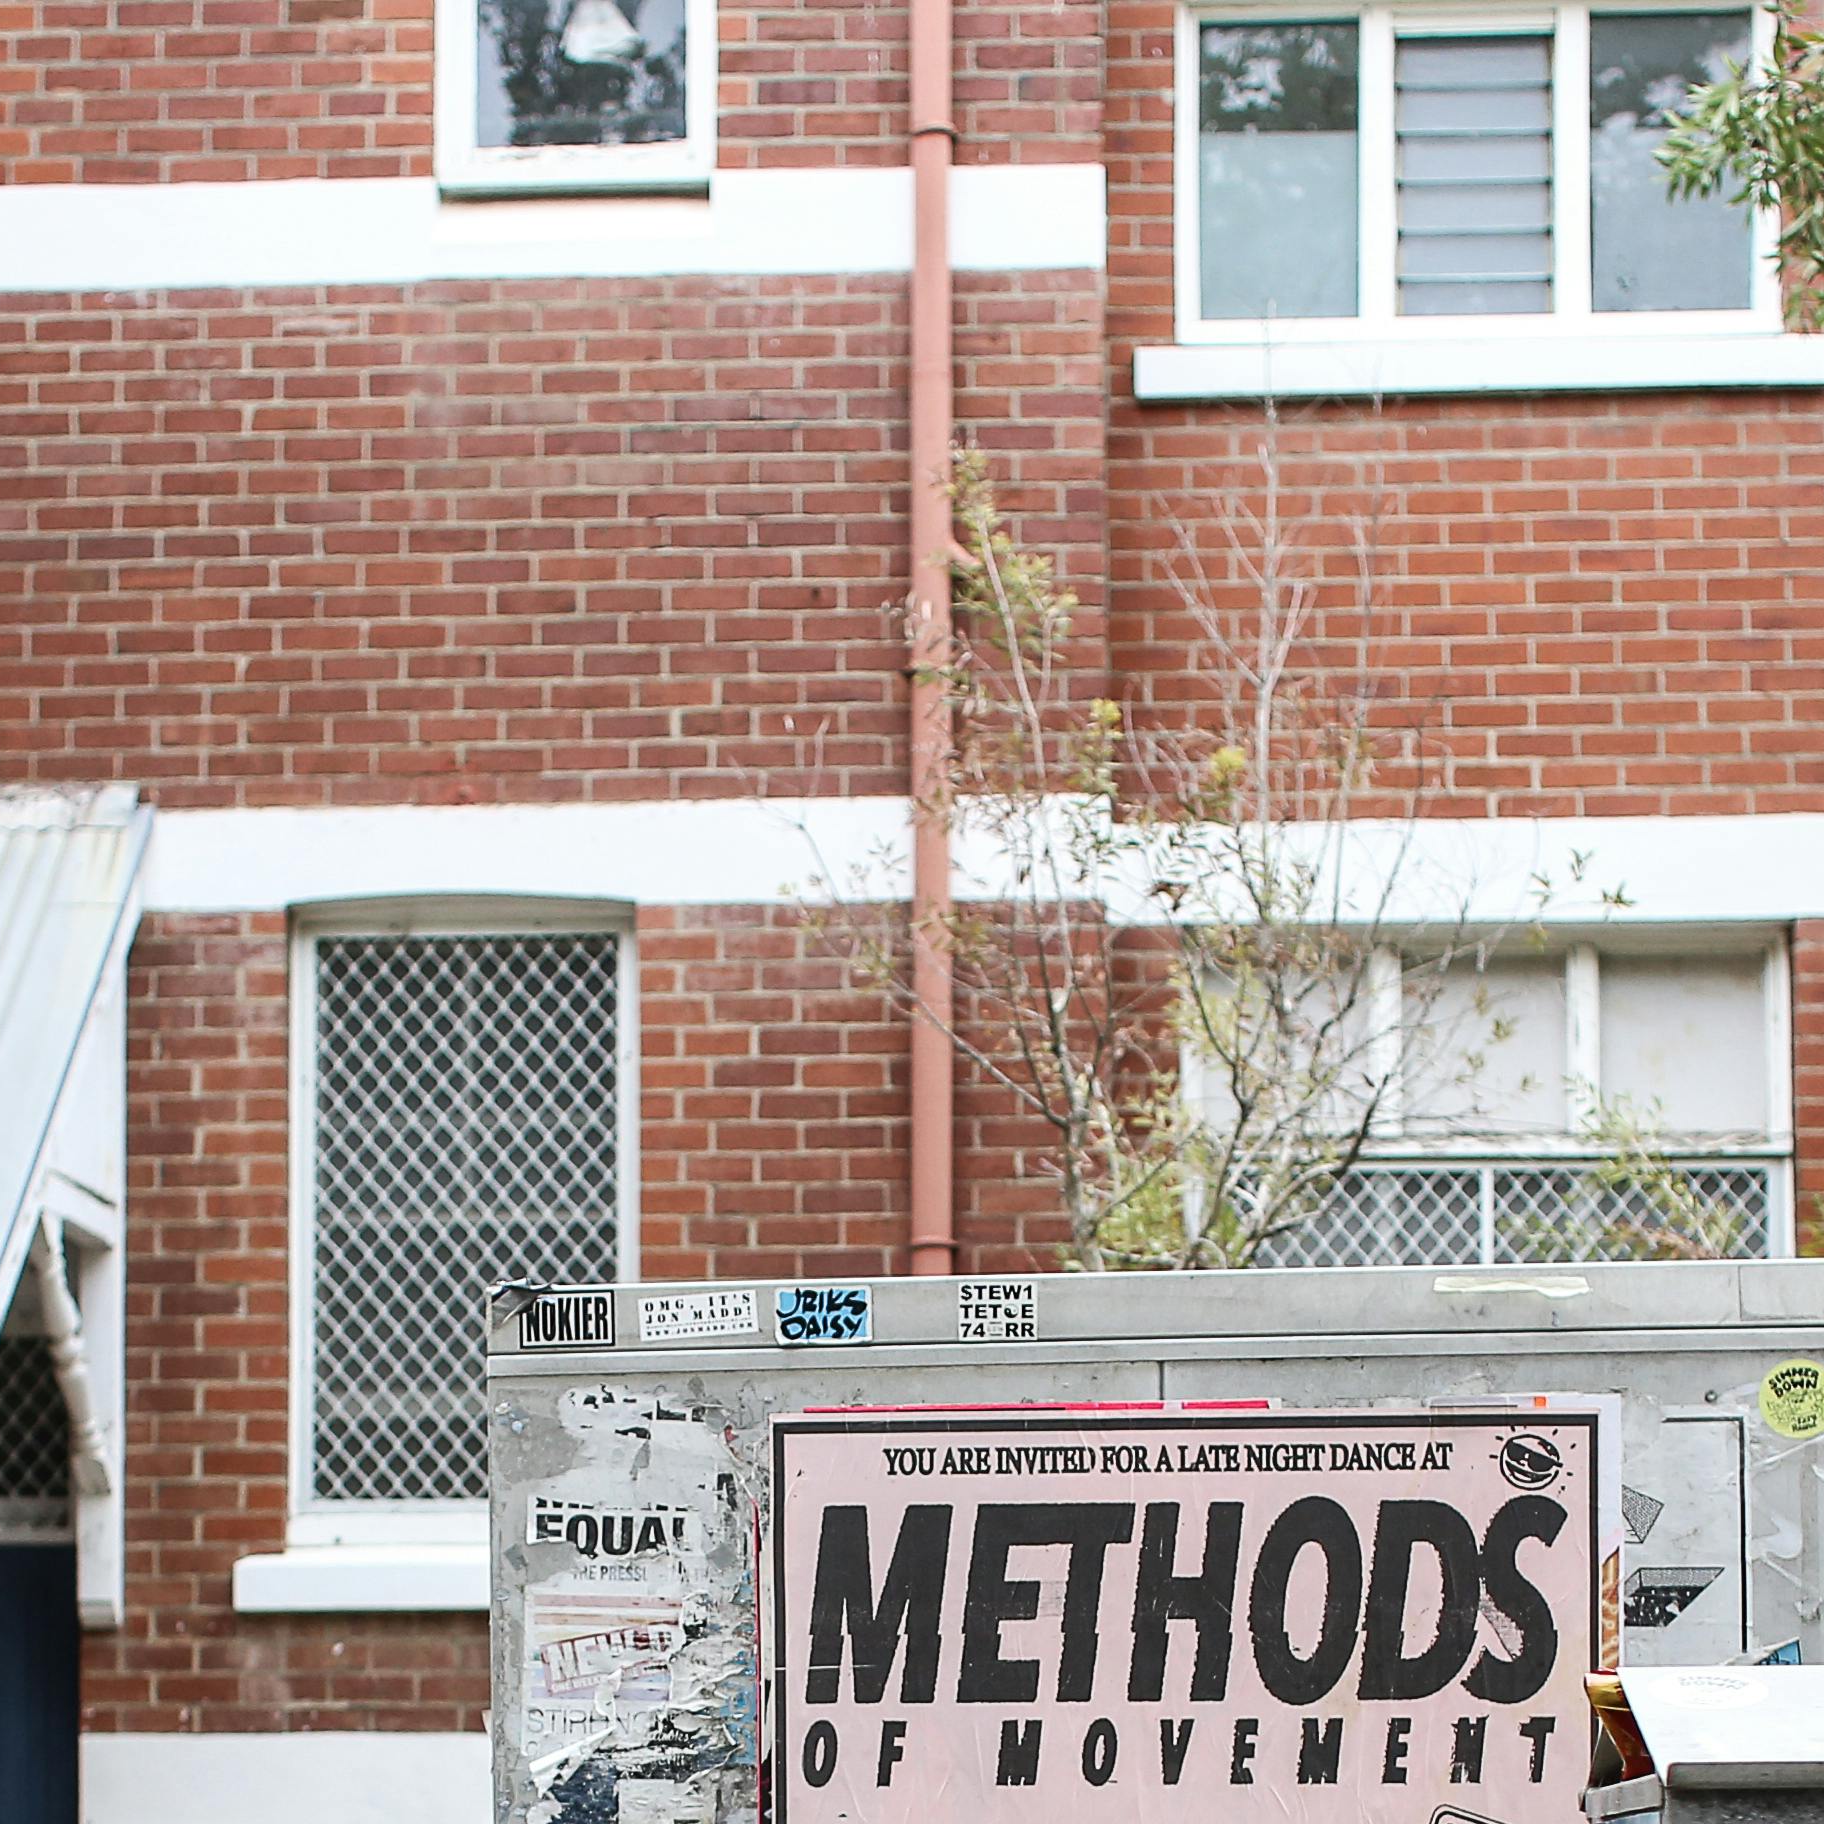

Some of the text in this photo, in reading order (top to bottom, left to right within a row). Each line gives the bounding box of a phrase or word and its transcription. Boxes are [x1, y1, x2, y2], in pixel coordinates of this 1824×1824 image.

[526, 1297, 609, 1342] NOKIER
[645, 1312, 679, 1324] JON
[882, 1442, 1454, 1476] YOU ARE INVITED FOR A LATE NIGHT DANCE AT
[805, 1494, 1568, 1706] METHODS
[802, 1714, 1557, 1788] OF MOVEMENT
